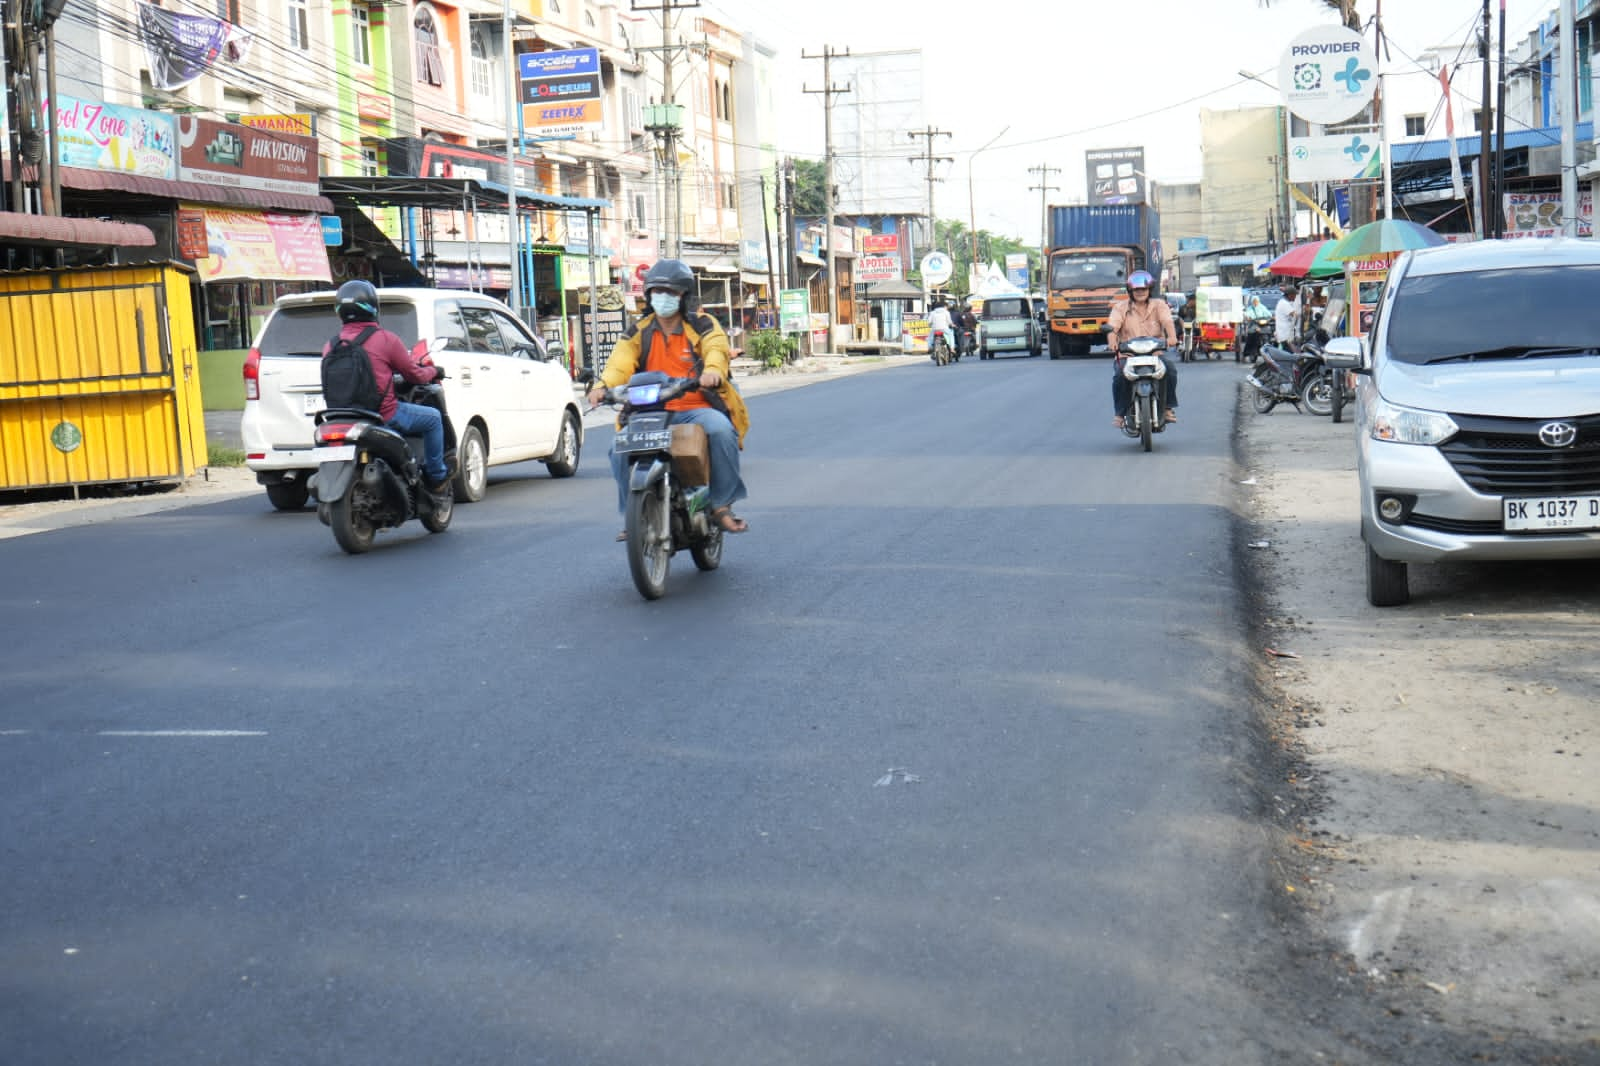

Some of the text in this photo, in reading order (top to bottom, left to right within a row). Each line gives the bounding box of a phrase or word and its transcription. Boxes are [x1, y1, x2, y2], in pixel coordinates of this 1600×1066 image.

[1292, 41, 1361, 56] PROVIDER
[541, 103, 587, 119] ZEETEX
[83, 103, 126, 147] Zone
[250, 137, 308, 163] HIKVISION
[859, 256, 894, 269] APOTEK
[1508, 502, 1528, 519] BK
[1537, 500, 1578, 518] 1037
